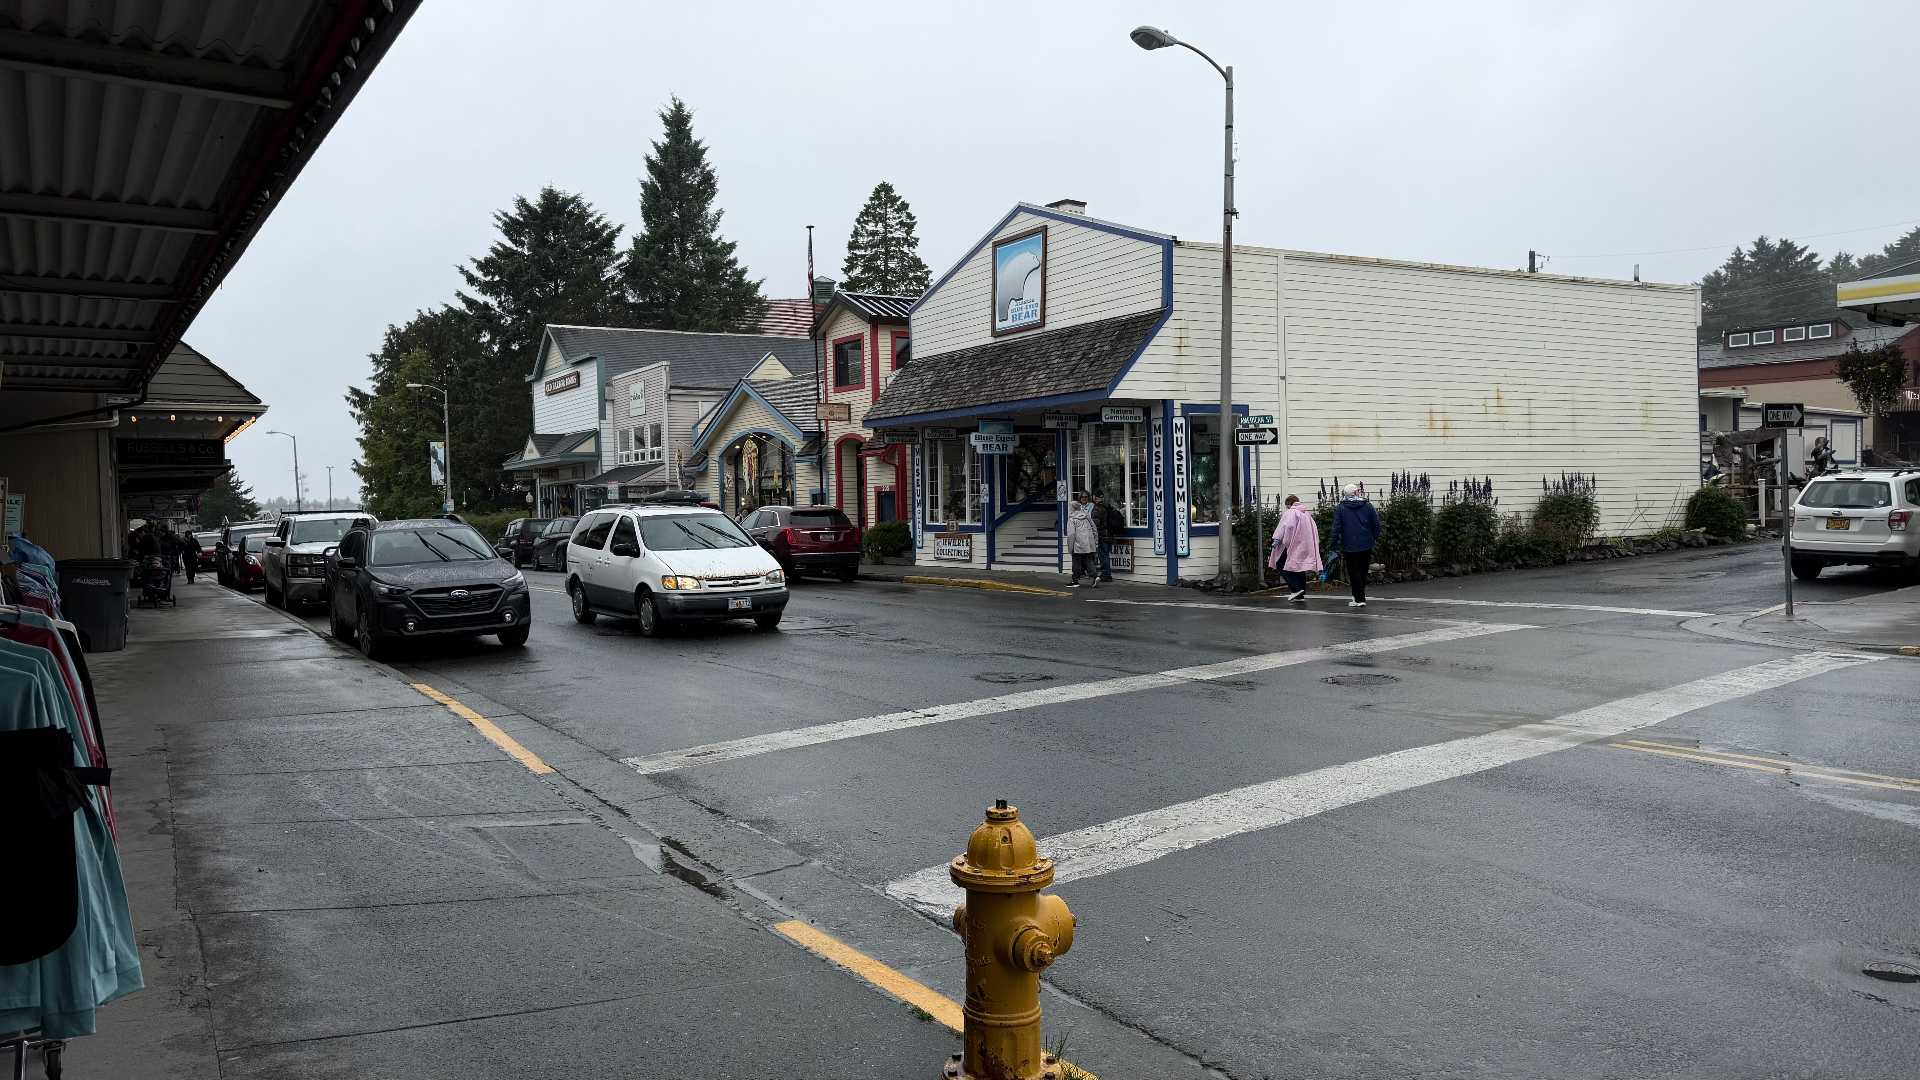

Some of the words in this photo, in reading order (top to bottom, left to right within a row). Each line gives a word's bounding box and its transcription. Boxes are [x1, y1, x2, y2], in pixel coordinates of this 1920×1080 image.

[1011, 303, 1038, 313] BLUE-EYED
[1011, 309, 1038, 322] BEAR
[565, 375, 577, 386] BOOKS
[1770, 411, 1780, 420] ONE
[1782, 411, 1793, 420] WAY
[995, 434, 1016, 443] Eyed
[1240, 433, 1252, 441] ONE
[127, 443, 186, 454] RUSSELL'S
[188, 444, 196, 454] &
[198, 443, 215, 454] Co.
[1153, 424, 1163, 502] MUSEUM
[1174, 423, 1186, 503] MUSEUM
[1155, 505, 1163, 550] QUALITY
[1178, 507, 1186, 551] QUALITY
[942, 538, 965, 547] JEWELRY
[936, 548, 969, 558] COLLECTIBLES
[1125, 545, 1130, 554] &
